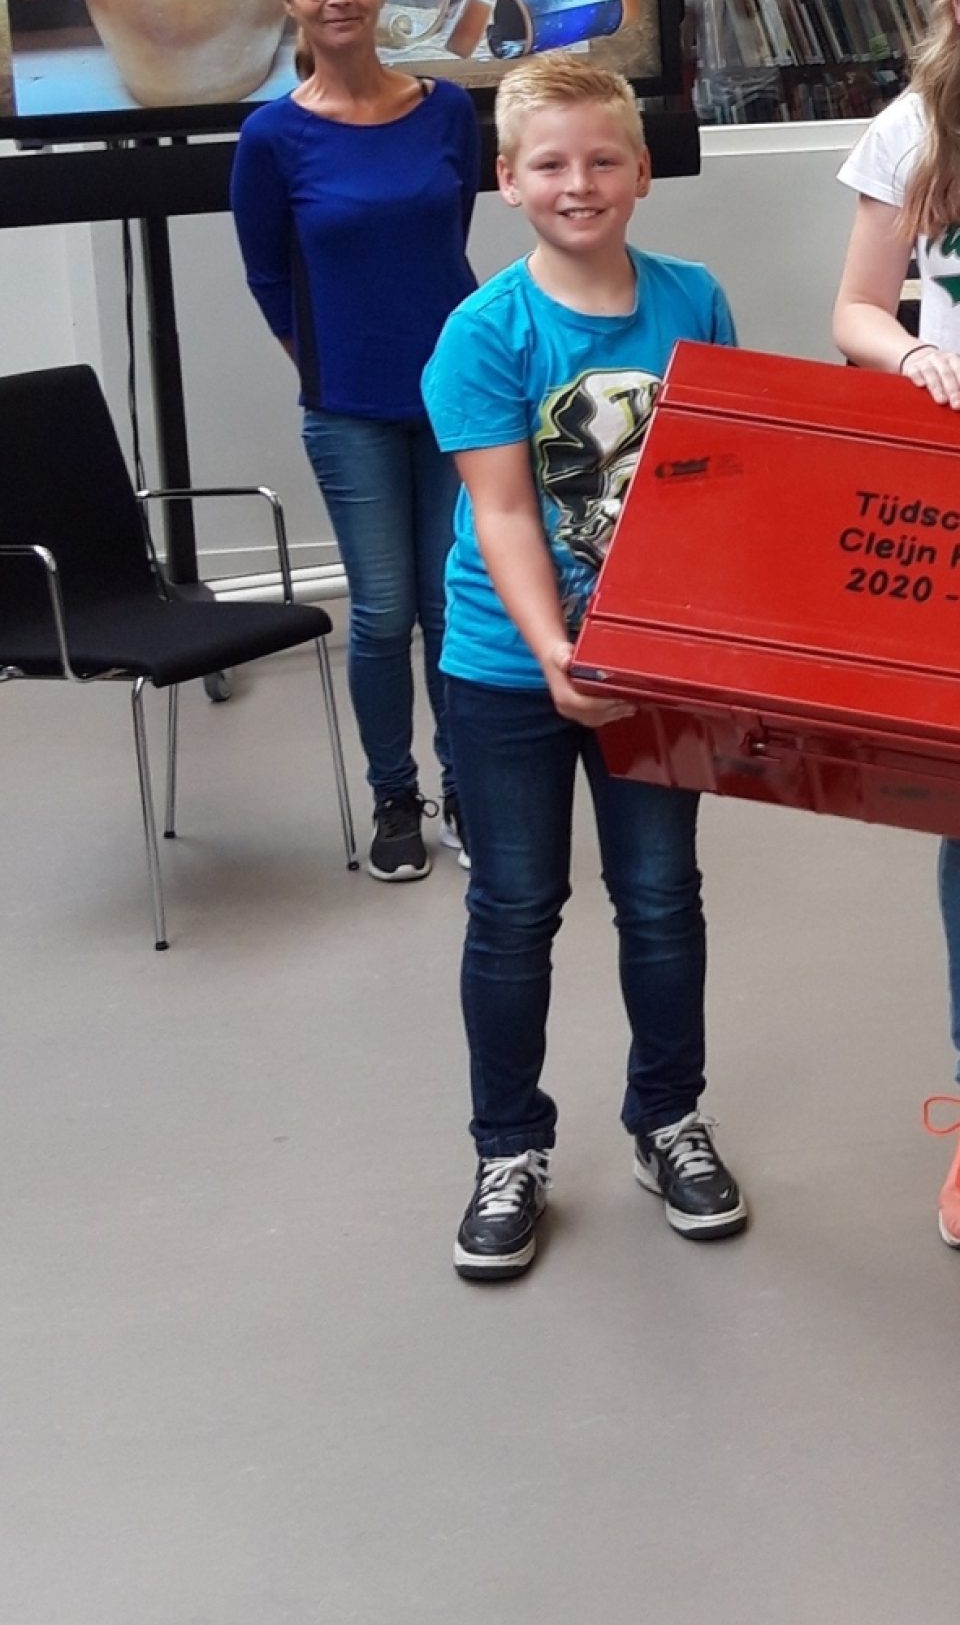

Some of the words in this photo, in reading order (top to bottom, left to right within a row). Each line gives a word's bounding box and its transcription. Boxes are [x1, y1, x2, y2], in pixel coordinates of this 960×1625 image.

[838, 527, 937, 567] Cleijn
[844, 567, 933, 603] 2020
[945, 592, 960, 601] -
